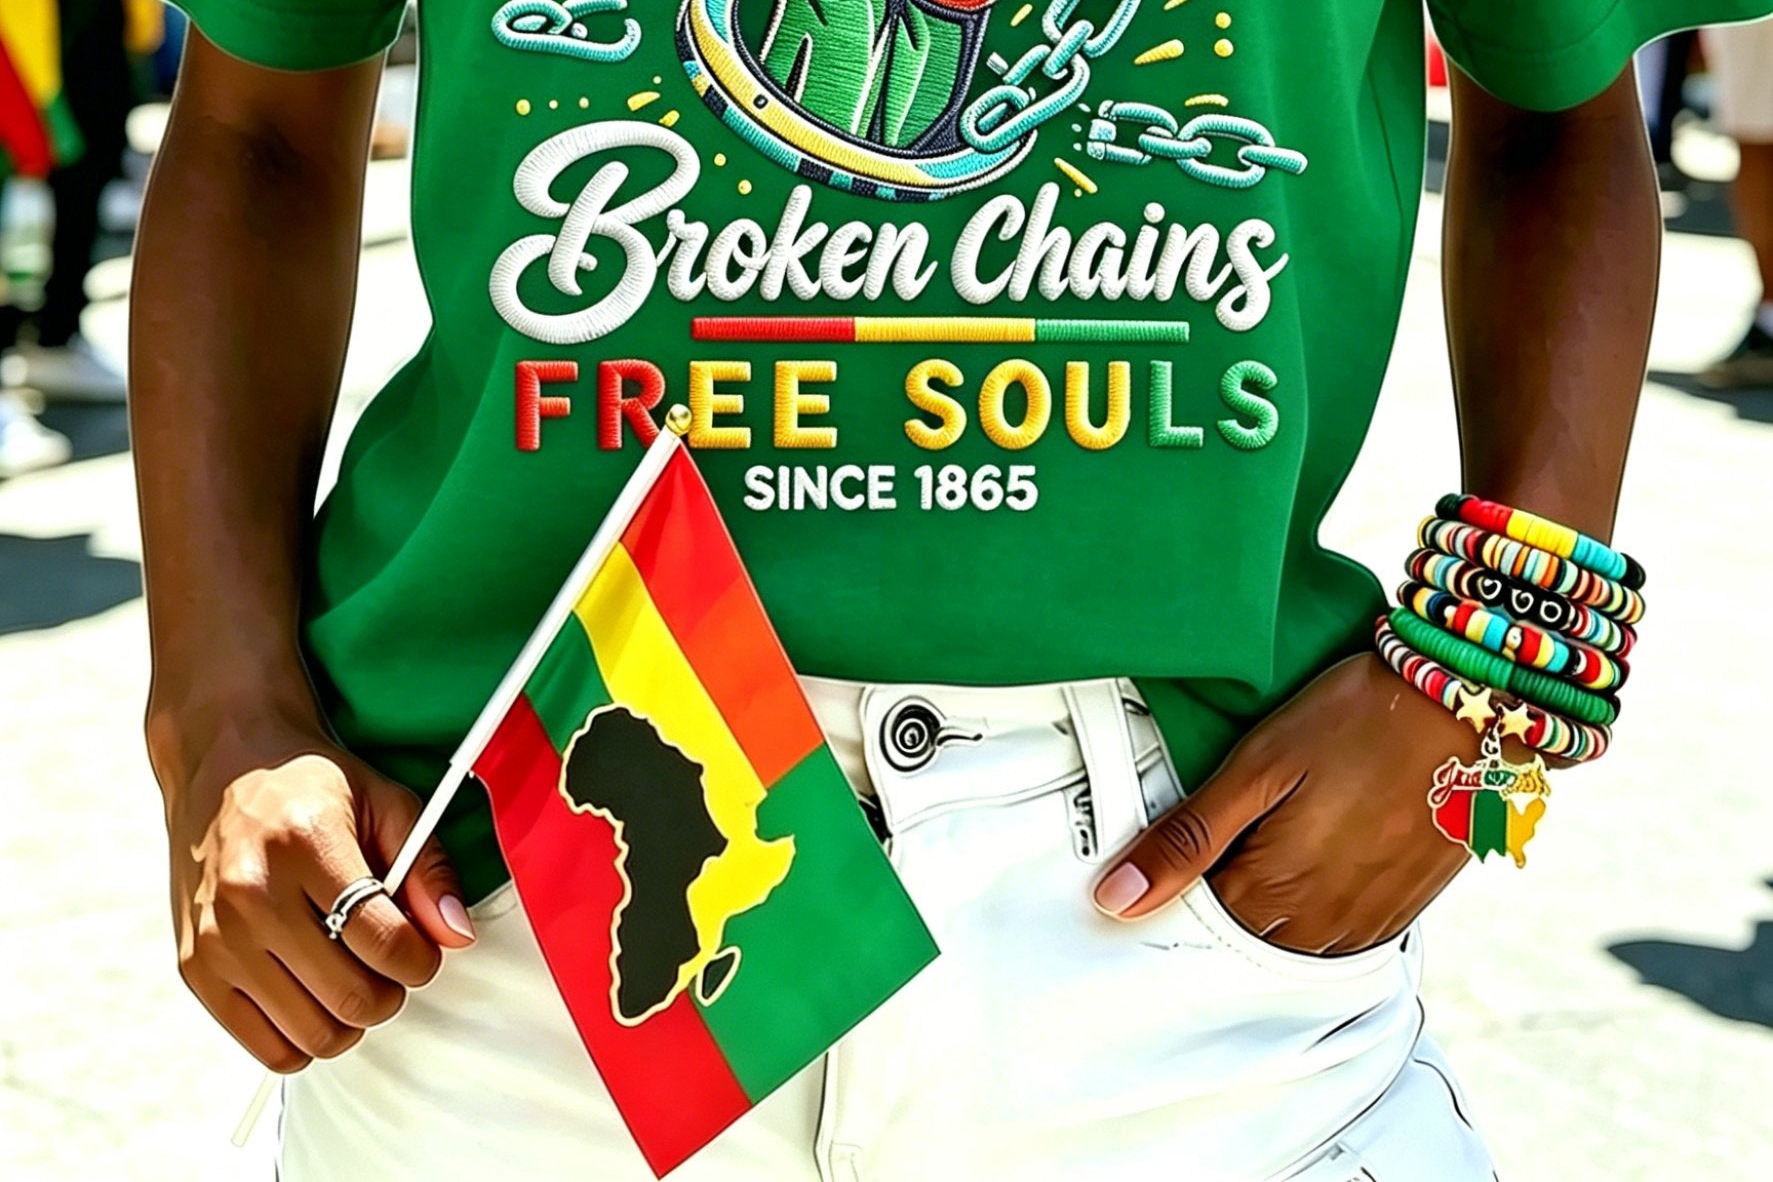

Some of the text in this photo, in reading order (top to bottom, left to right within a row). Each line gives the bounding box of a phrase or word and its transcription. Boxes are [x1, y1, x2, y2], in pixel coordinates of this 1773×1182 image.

[489, 119, 1290, 345] Broken Chains
[513, 358, 1280, 452] FREE SOULS
[742, 464, 1039, 511] SINCE 1865
